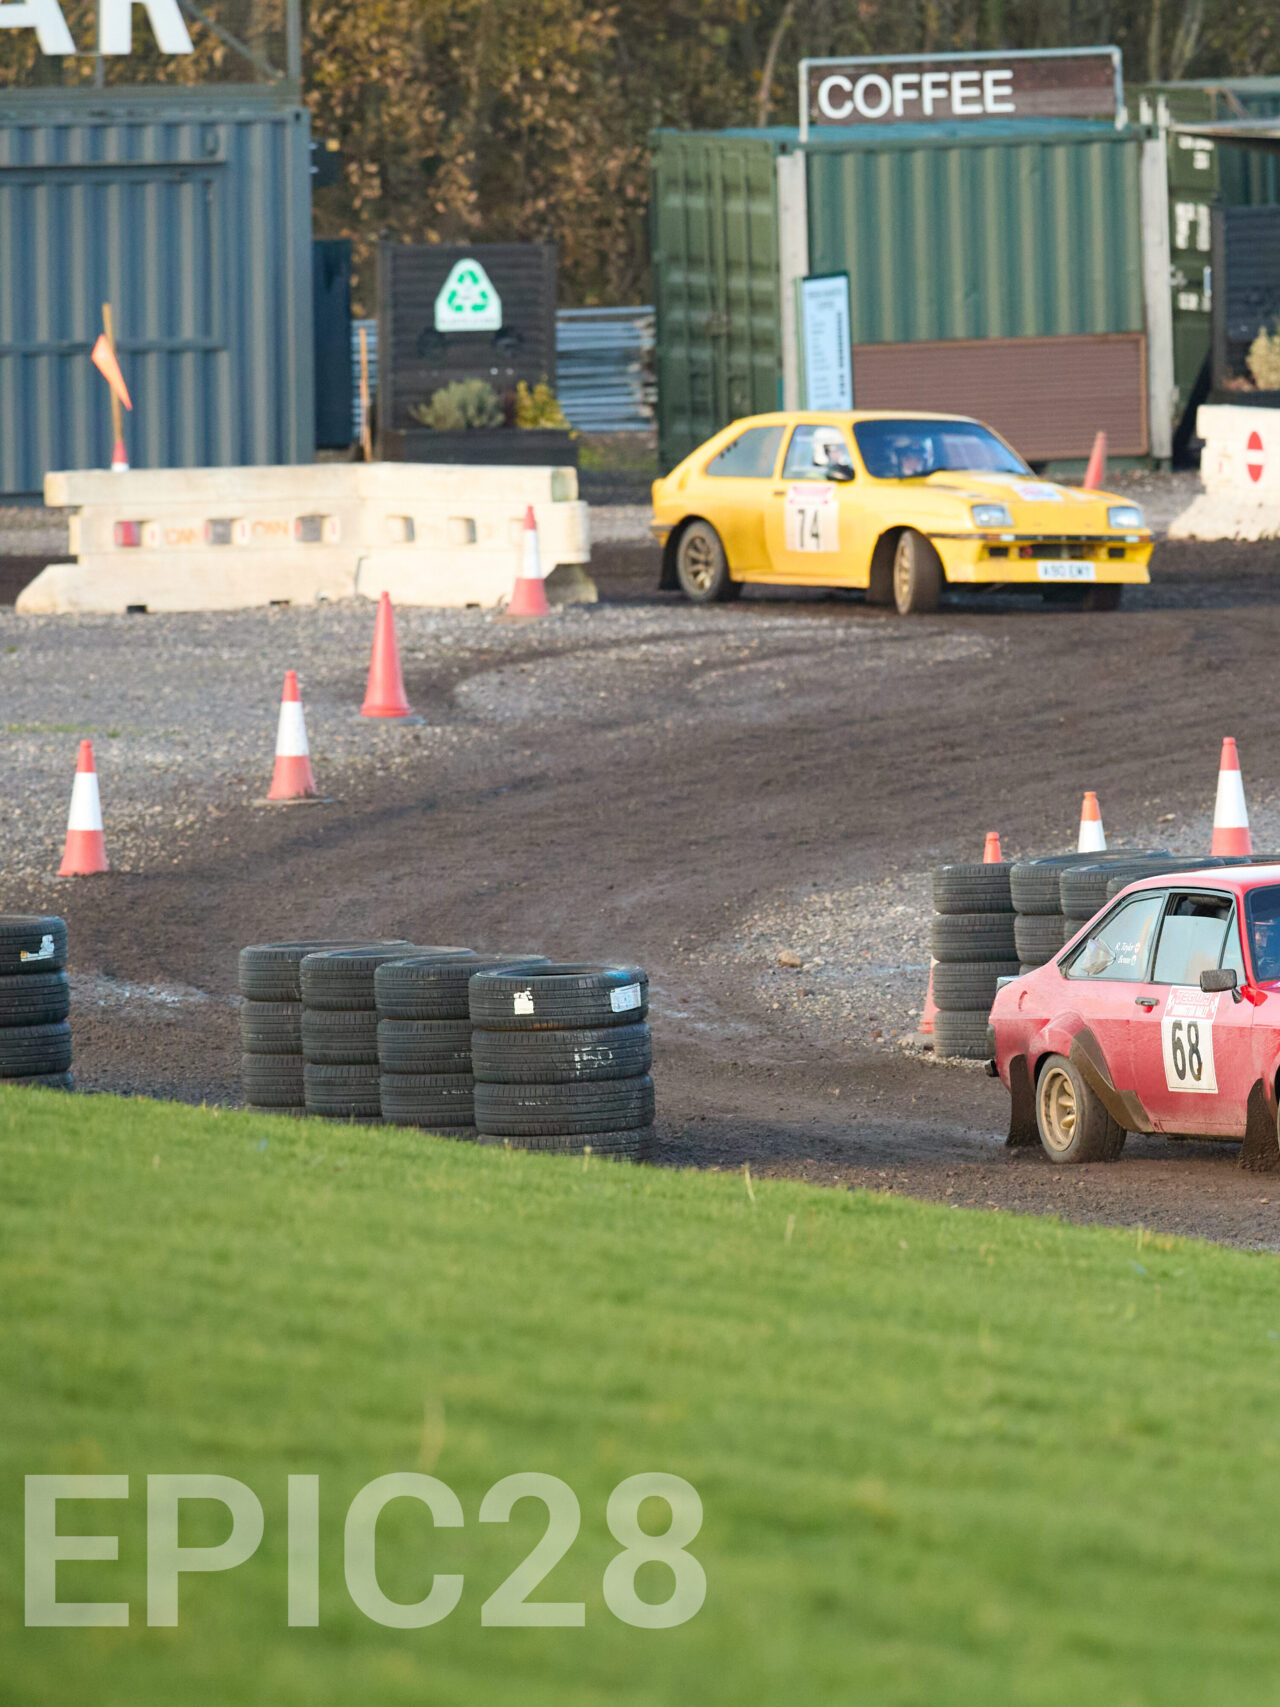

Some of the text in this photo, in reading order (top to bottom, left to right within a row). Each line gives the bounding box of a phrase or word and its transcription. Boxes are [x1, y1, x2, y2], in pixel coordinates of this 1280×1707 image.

[817, 69, 1016, 119] COFFEE
[797, 508, 820, 550] 74
[1171, 1019, 1202, 1081] 68
